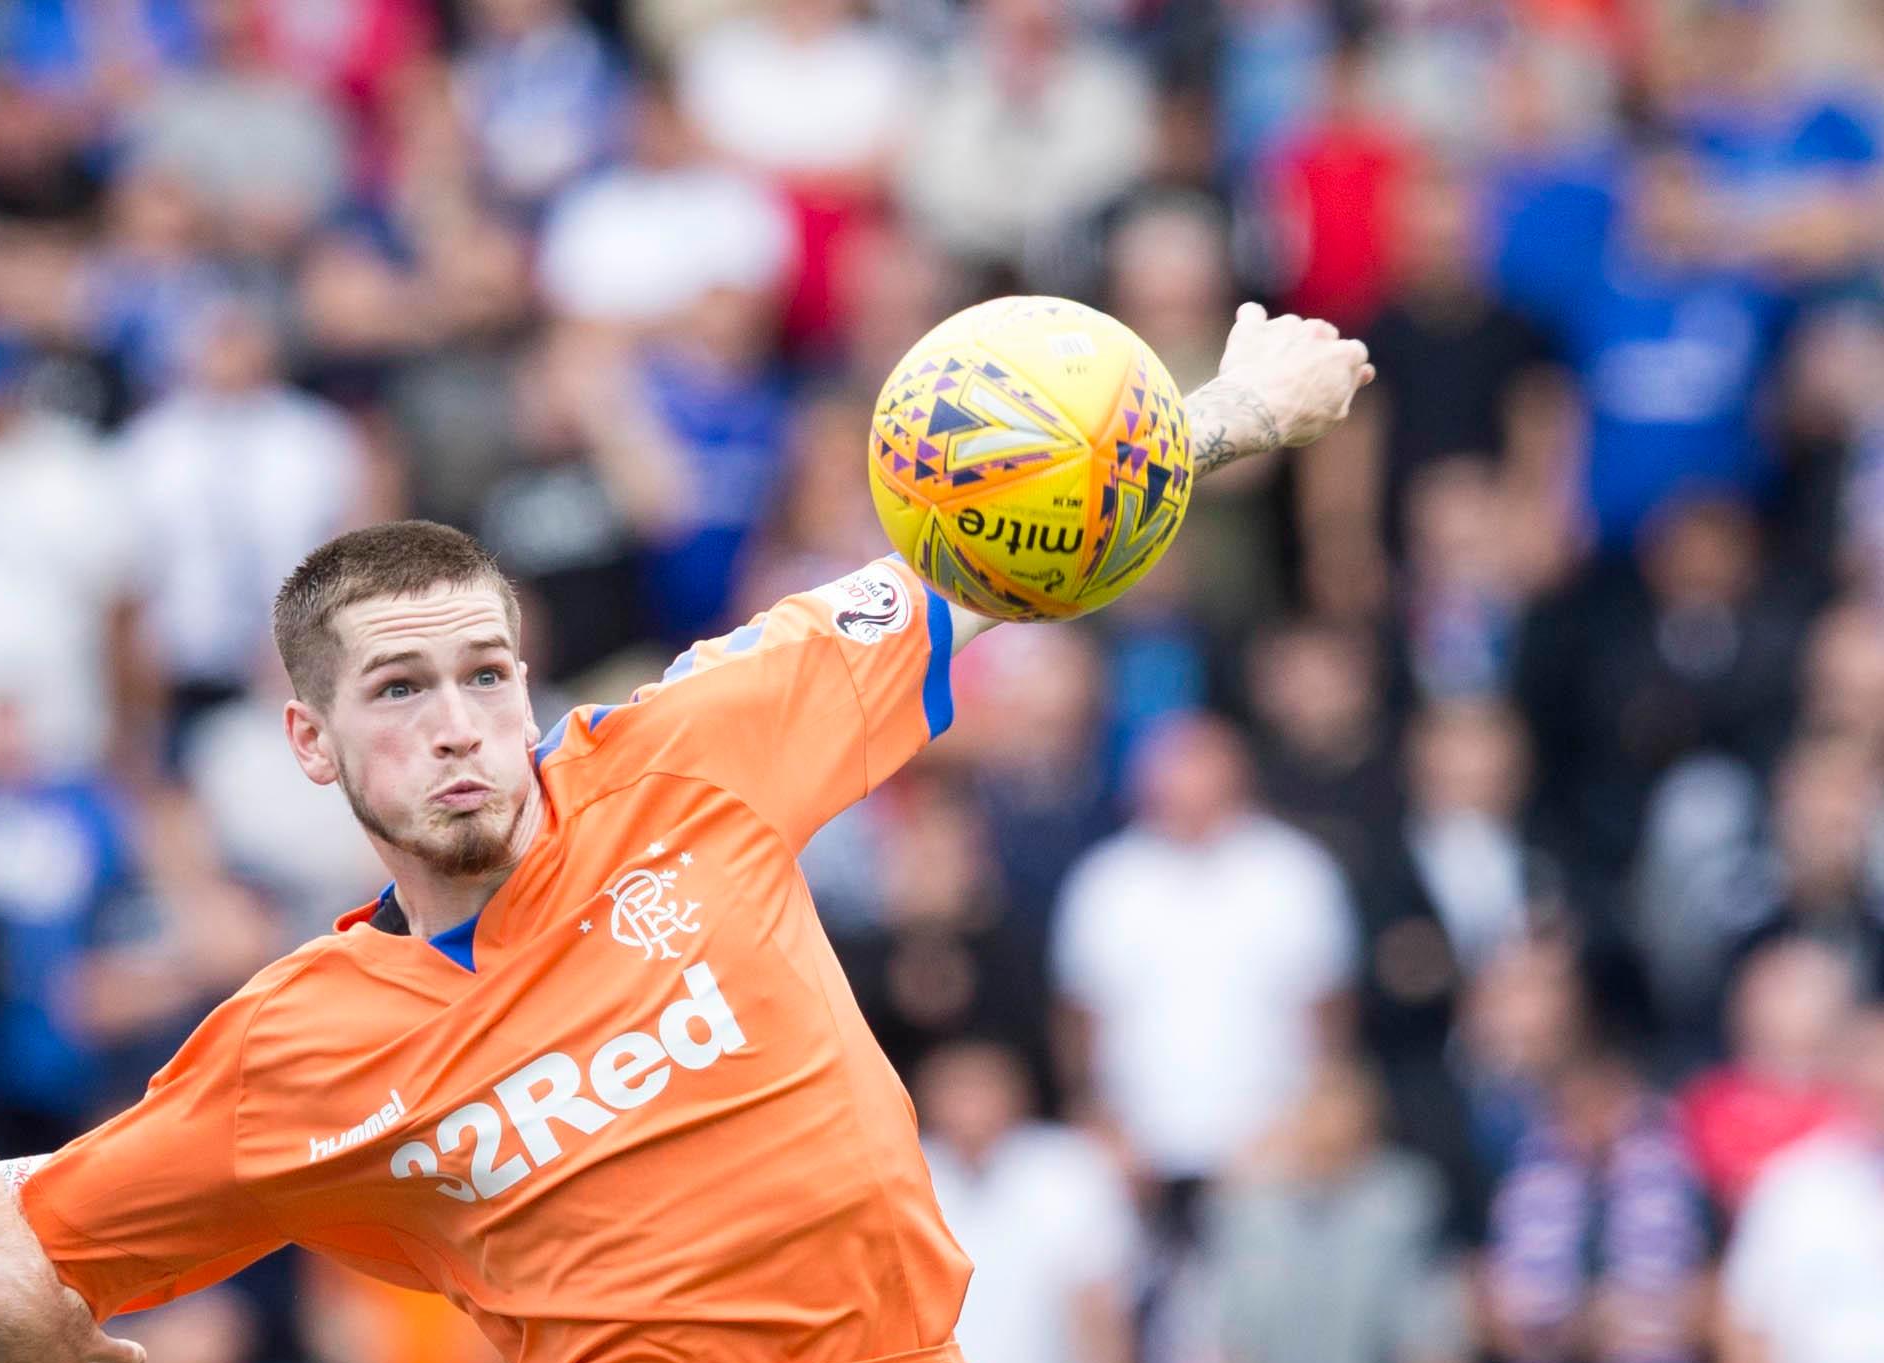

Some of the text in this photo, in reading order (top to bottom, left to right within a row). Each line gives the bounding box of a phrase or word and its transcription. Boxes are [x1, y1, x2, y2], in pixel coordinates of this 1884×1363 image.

[957, 506, 1085, 556] mitre
[390, 961, 747, 1203] 32Red
[309, 1088, 406, 1163] hummel
